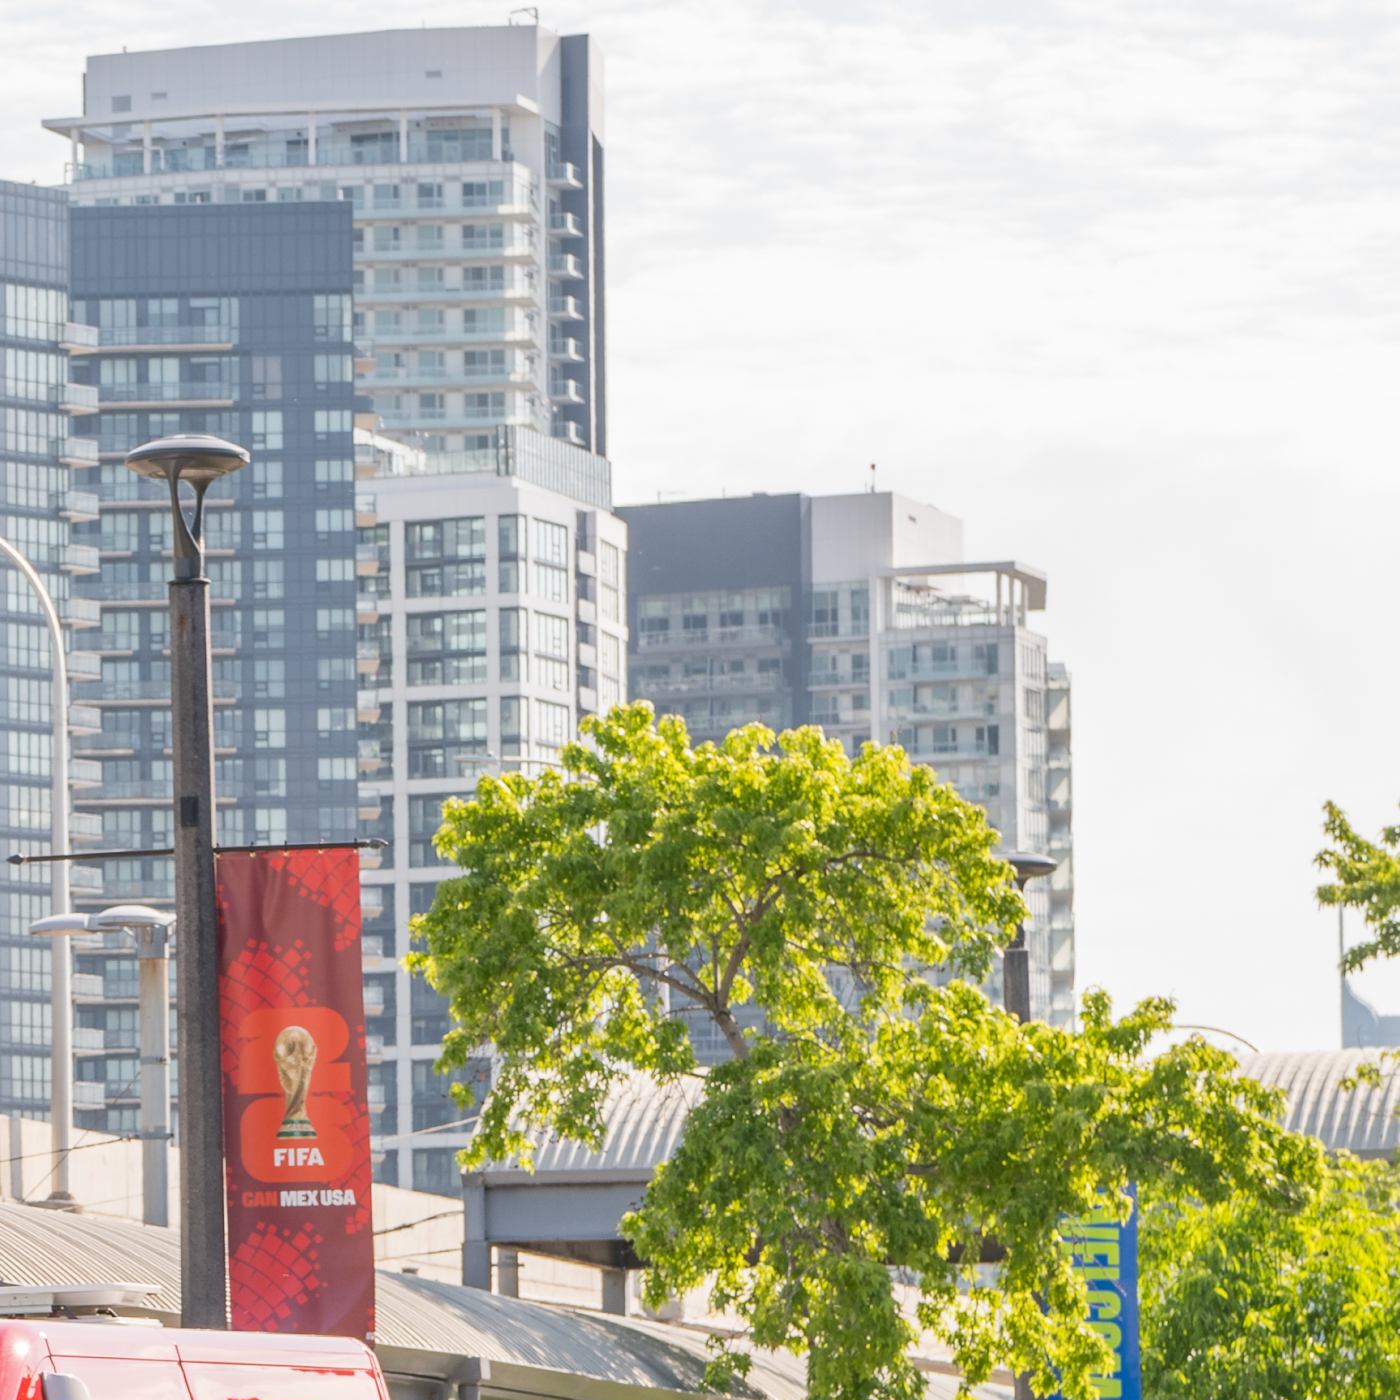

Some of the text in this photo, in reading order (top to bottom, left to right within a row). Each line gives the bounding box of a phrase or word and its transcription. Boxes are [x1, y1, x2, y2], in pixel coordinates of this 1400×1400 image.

[273, 1147, 325, 1167] FIFA
[241, 1188, 356, 1208] CAN MEX USA
